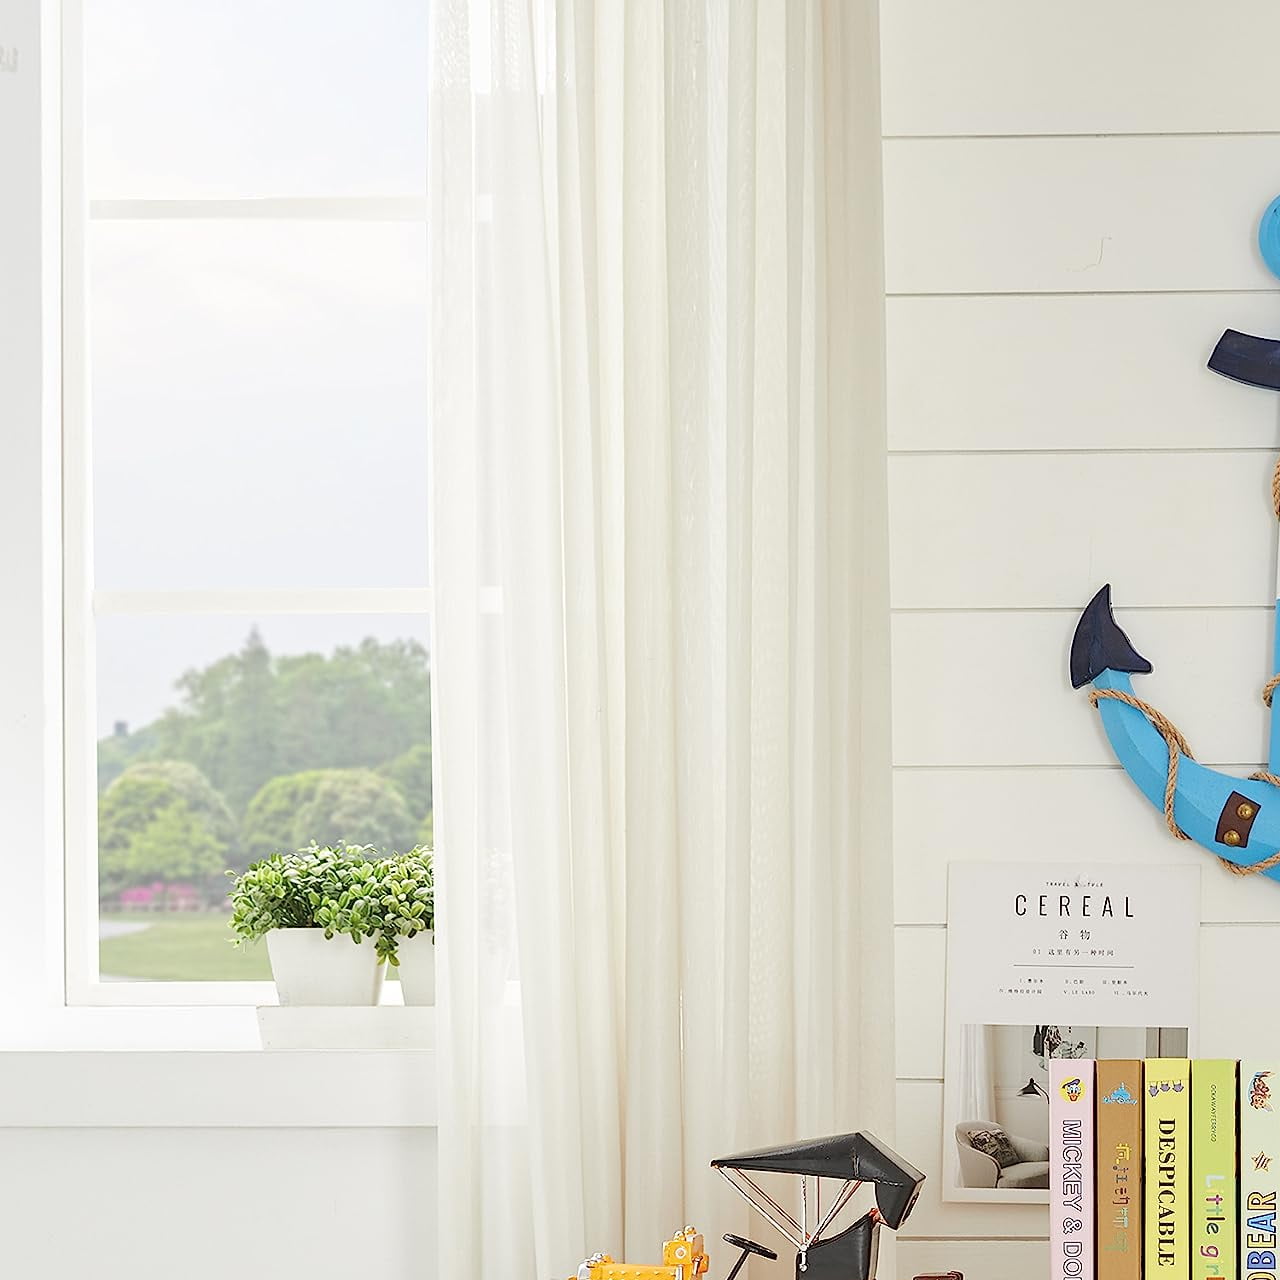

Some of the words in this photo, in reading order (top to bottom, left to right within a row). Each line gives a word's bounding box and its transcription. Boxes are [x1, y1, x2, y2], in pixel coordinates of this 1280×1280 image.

[1015, 894, 1134, 918] CEREAL
[1062, 1119, 1082, 1212] MICKEY
[1158, 1118, 1176, 1266] DESPICABLE
[1062, 1217, 1082, 1235] &
[1205, 1175, 1226, 1235] Little
